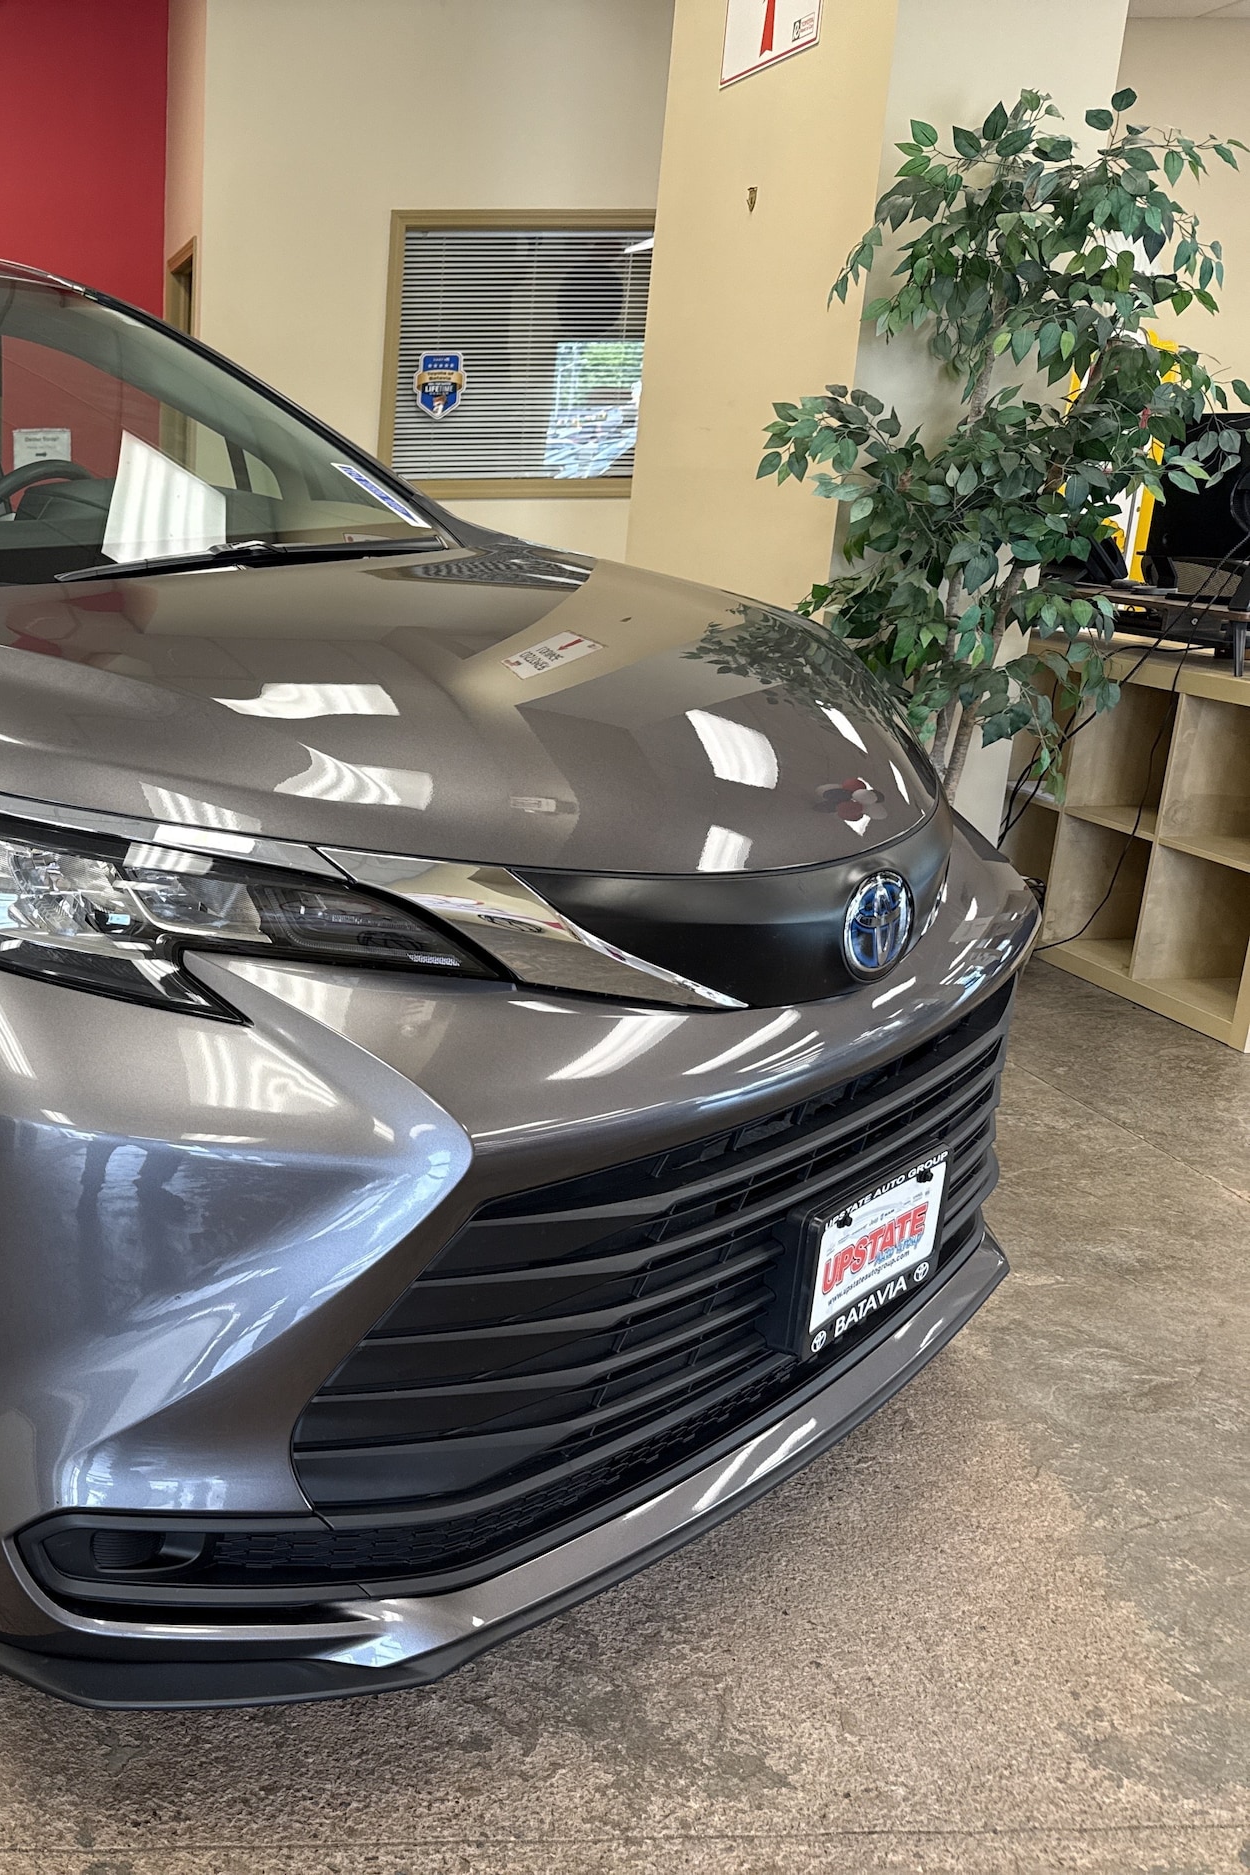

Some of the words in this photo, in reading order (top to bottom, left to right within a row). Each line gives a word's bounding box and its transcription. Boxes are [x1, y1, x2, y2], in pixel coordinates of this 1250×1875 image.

[424, 384, 454, 393] LIFETIME
[873, 1174, 905, 1198] AUTO
[907, 1151, 948, 1177] GROUP
[822, 1201, 929, 1295] UPSTATE
[827, 1250, 910, 1306] www.upstateautogroup.com
[834, 1275, 907, 1337] BATAVIA
